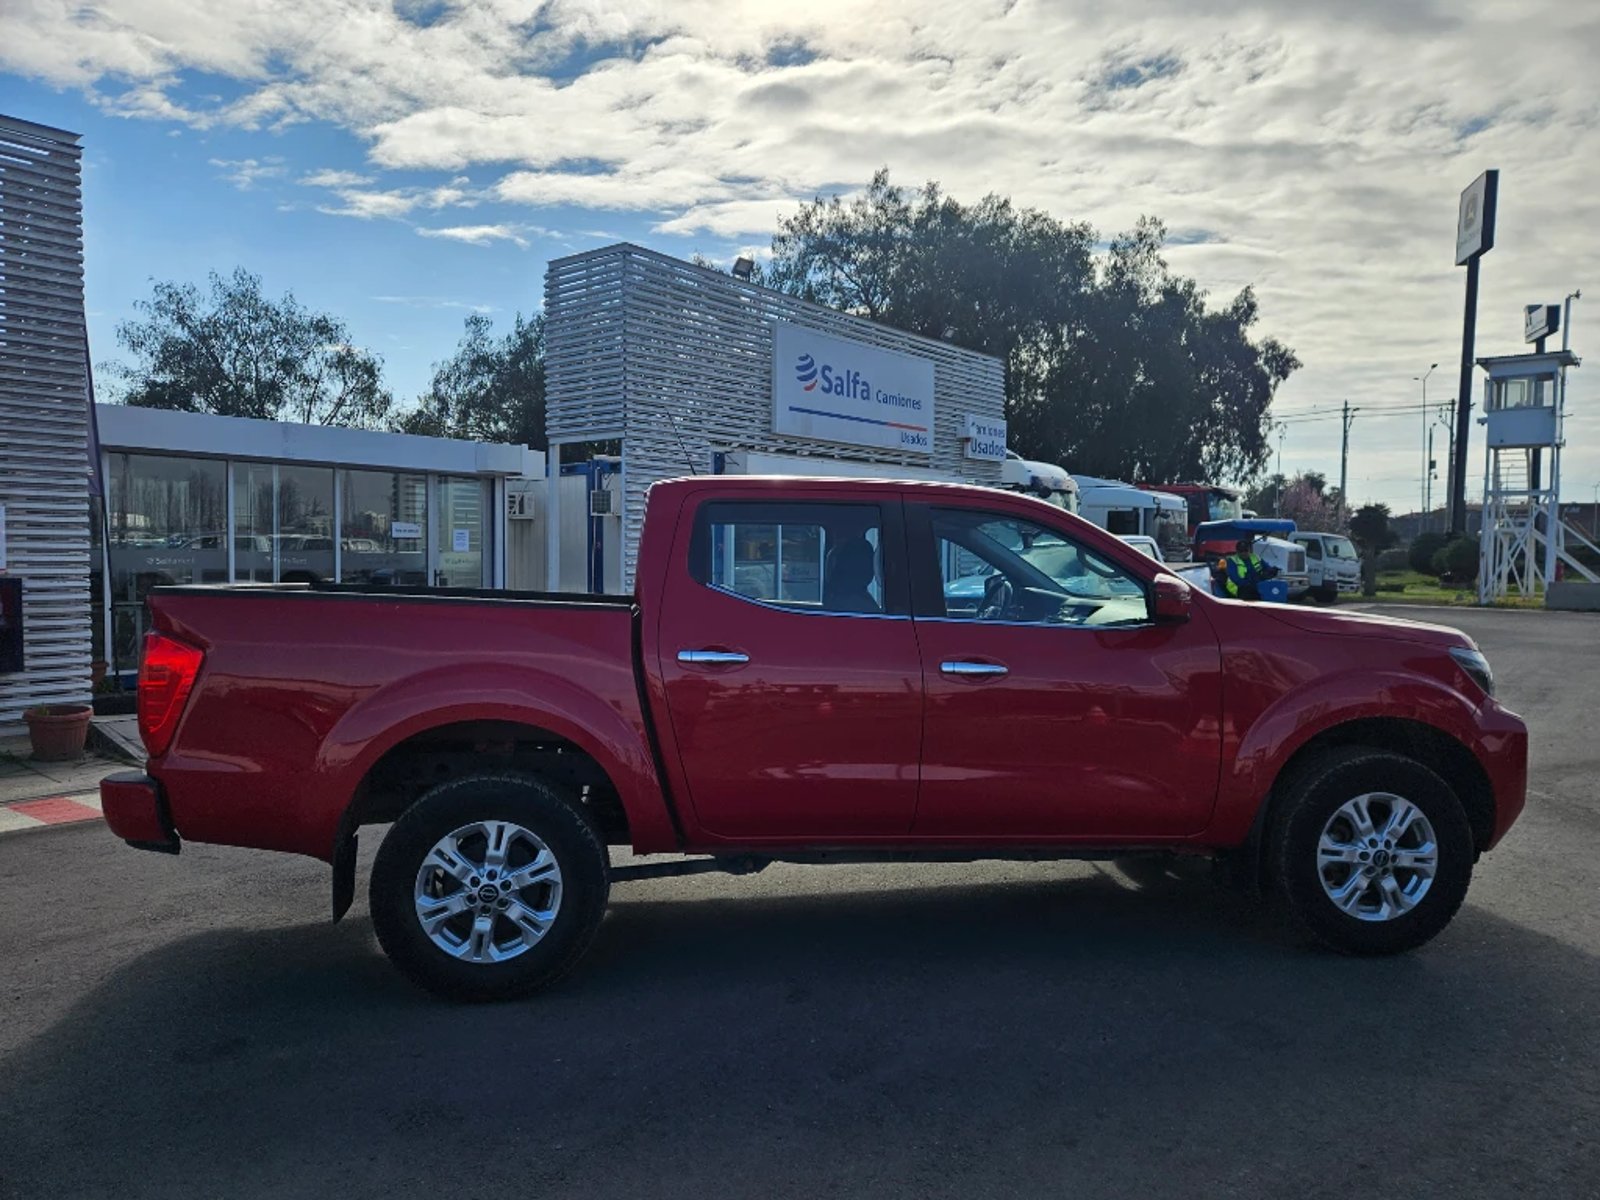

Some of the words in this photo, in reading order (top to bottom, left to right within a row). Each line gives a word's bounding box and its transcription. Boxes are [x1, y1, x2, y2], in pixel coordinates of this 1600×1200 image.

[820, 365, 870, 401] Salfa
[876, 390, 922, 410] Camiones
[901, 432, 928, 446] Usados
[971, 438, 1004, 457] Usados
